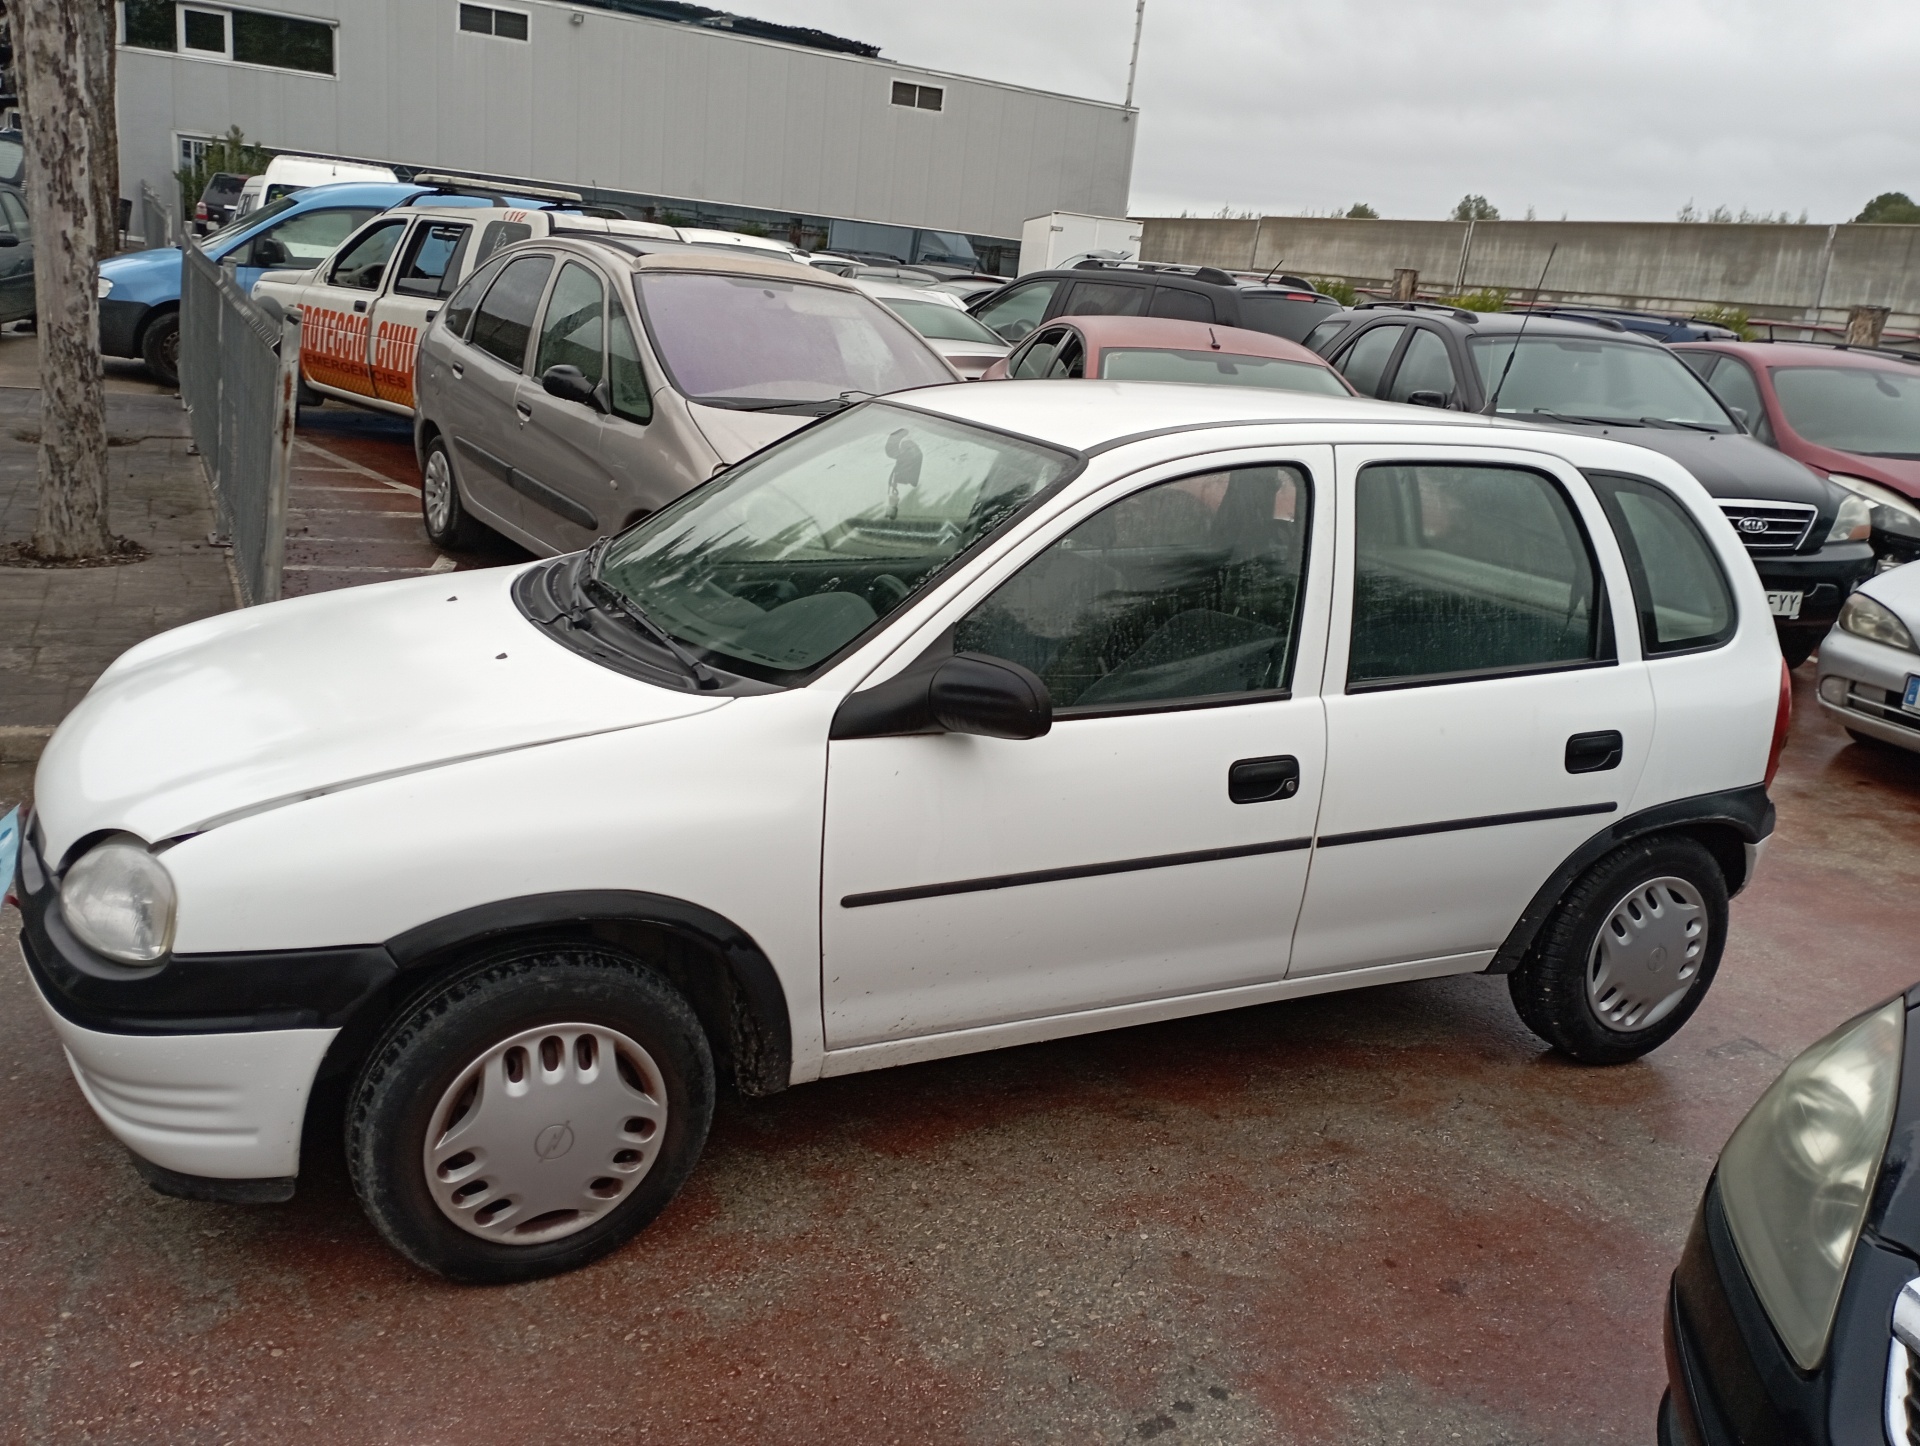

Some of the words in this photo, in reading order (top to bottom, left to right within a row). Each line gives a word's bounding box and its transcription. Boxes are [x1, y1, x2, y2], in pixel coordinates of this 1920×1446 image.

[509, 210, 527, 222] 112
[303, 353, 407, 388] EMERGENCIES
[1743, 520, 1763, 530] KIA
